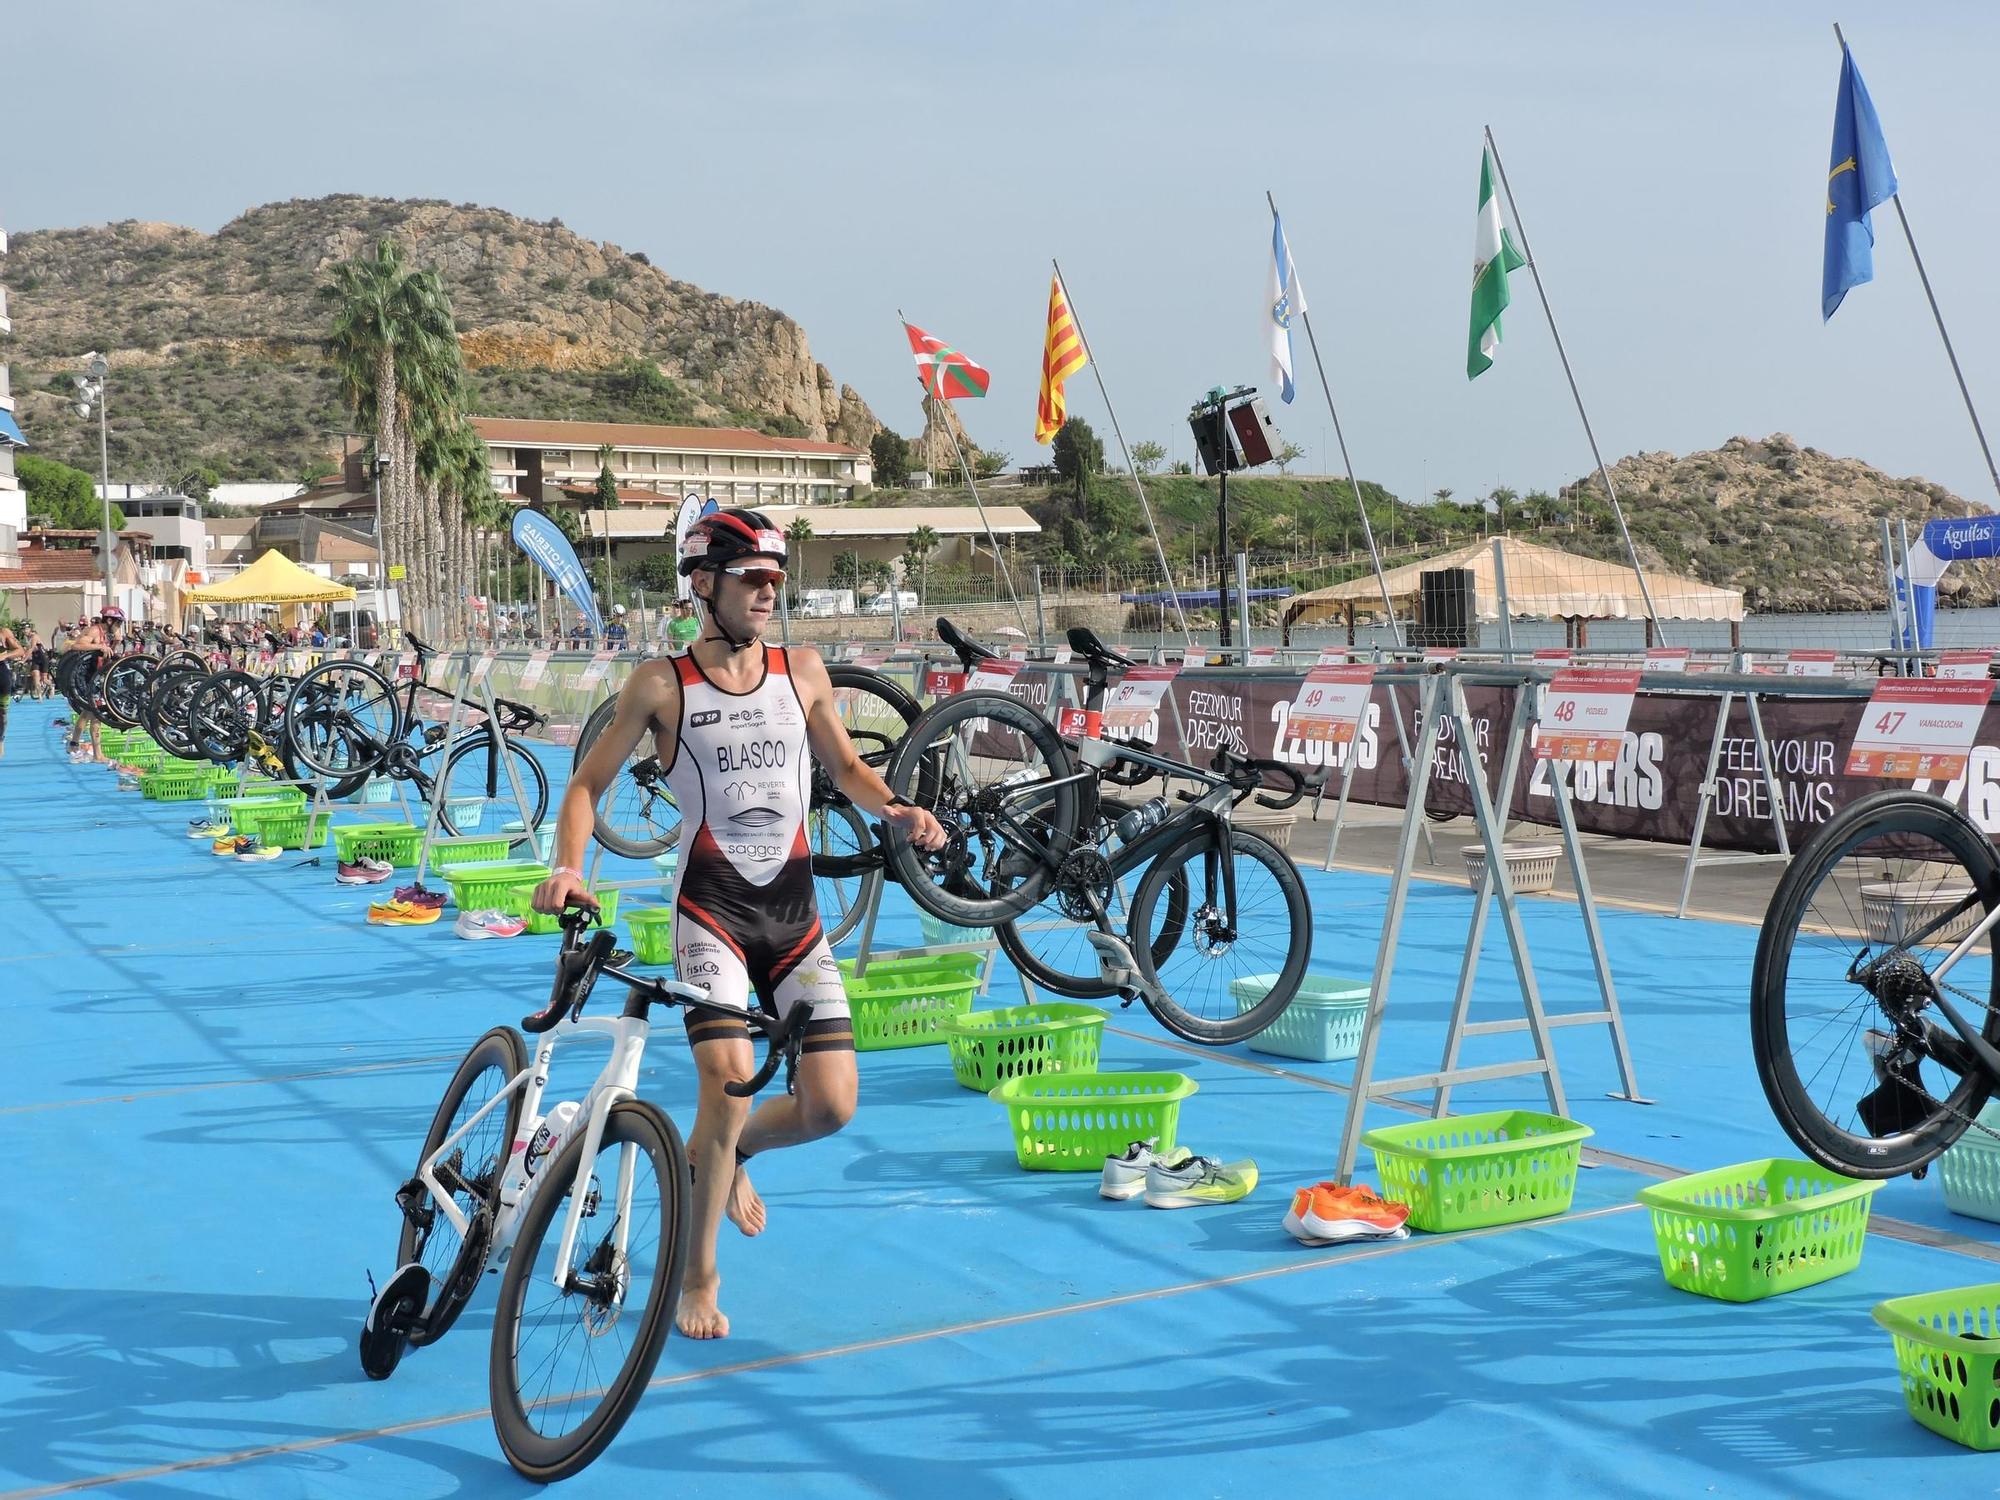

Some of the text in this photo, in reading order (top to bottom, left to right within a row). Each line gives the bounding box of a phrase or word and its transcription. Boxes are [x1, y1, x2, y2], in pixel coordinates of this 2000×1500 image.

[193, 594, 231, 602] PATRONATO
[937, 676, 948, 686] 51
[1030, 684, 1048, 705] YOU
[1119, 686, 1134, 700] 50
[1305, 689, 1323, 707] 49
[706, 712, 718, 722] SP
[1213, 695, 1242, 721] YOUR
[1554, 701, 1575, 721] 48
[1071, 713, 1086, 726] 50
[1875, 711, 1963, 734] 47 VANACLOCHA
[1187, 719, 1249, 755] DREAMS
[717, 740, 785, 773] BLASCO
[1771, 739, 1834, 775] YOUR
[758, 781, 786, 789] REVERTE
[1715, 777, 1834, 824] DREAMS
[728, 845, 782, 857] saggas
